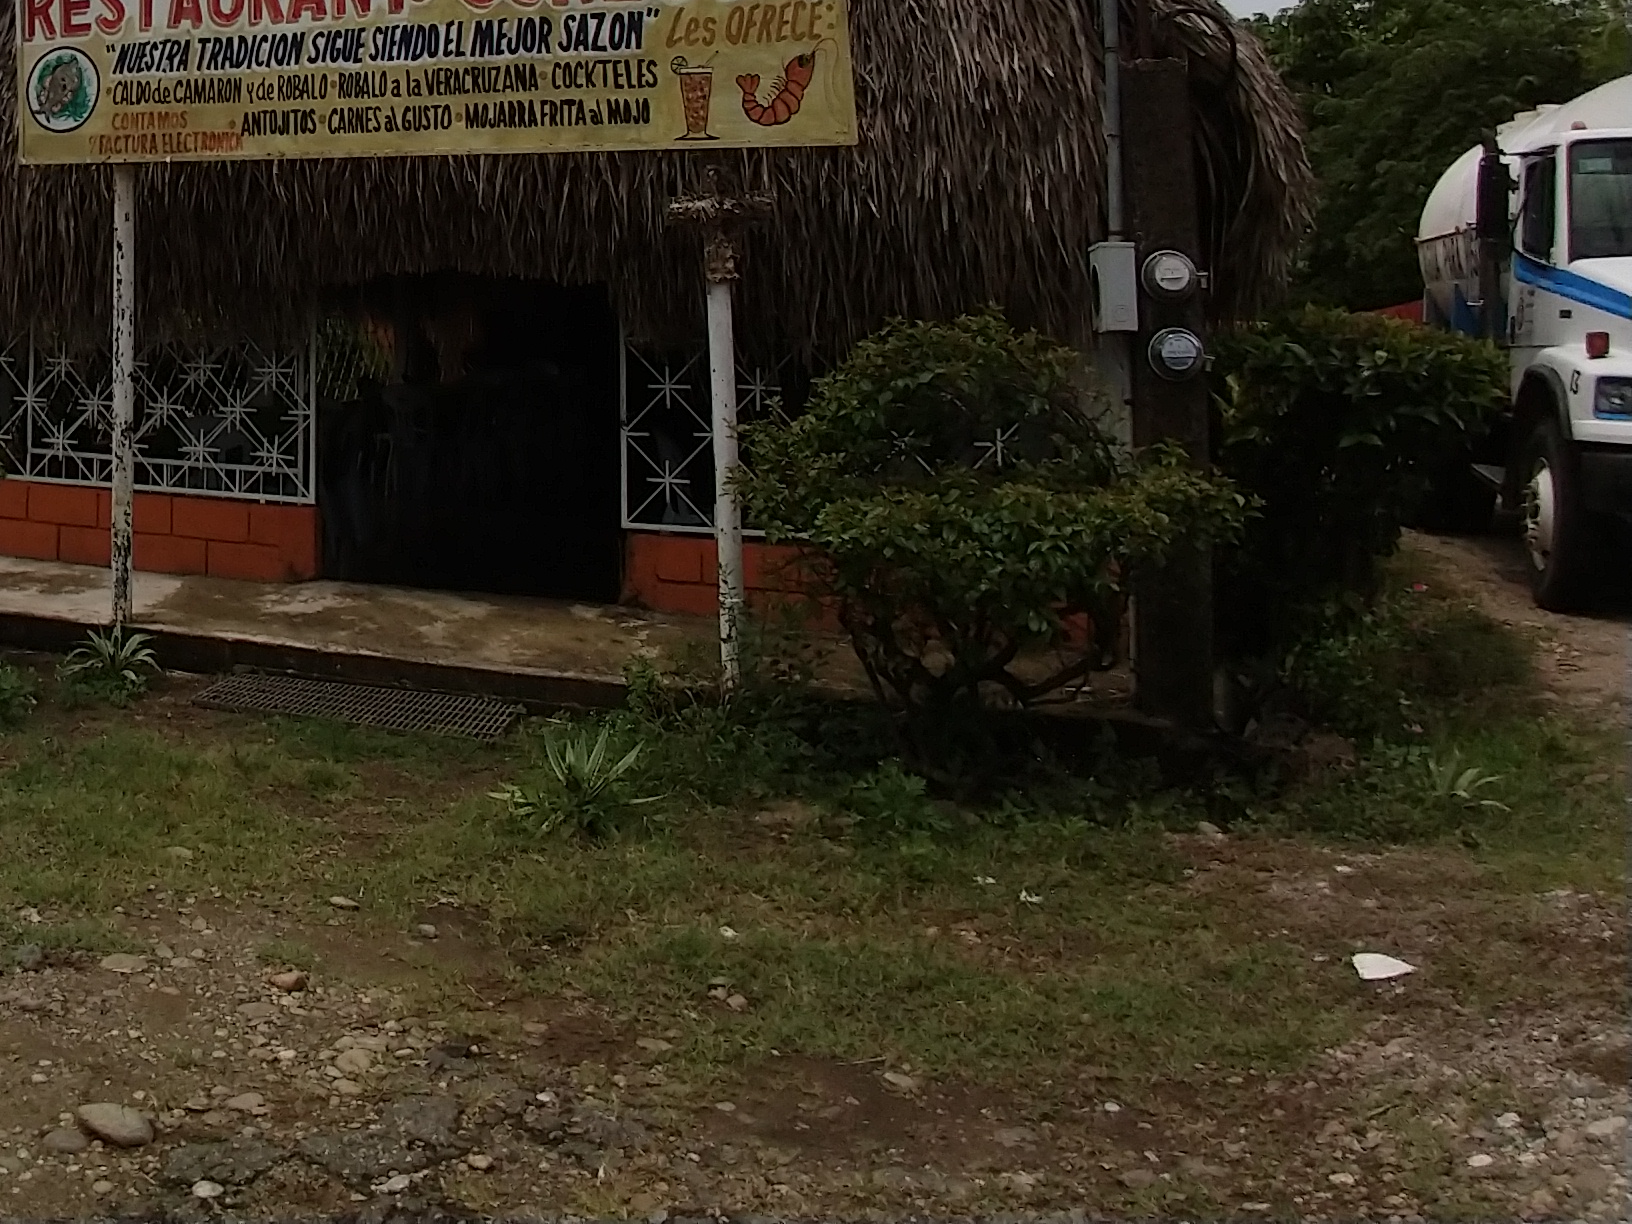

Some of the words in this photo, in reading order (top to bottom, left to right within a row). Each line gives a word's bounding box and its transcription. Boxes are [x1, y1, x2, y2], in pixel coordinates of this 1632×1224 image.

[196, 32, 306, 72] TRADICION
[306, 27, 366, 65] SIGUE
[368, 23, 440, 62] SIENDO
[442, 19, 466, 58] EL
[469, 16, 553, 58] MEJOR
[112, 79, 152, 106] CALDO
[151, 77, 172, 106] de
[173, 77, 242, 105] CAMARON
[255, 76, 275, 102] de
[277, 73, 328, 102] ROBALO
[337, 70, 388, 100] ROBALO
[390, 78, 402, 98] a
[405, 68, 423, 98] la
[424, 63, 539, 97] VERACRUZANA
[551, 59, 659, 91] COCKTELES
[240, 108, 317, 138] ANTOJITOS
[327, 105, 382, 135] CARNES
[384, 105, 401, 132] al
[401, 103, 453, 132] GUSTO
[464, 98, 539, 130] MOJARRA
[539, 98, 587, 127] FRITA
[587, 97, 604, 126] al
[606, 96, 651, 126] MOJO
